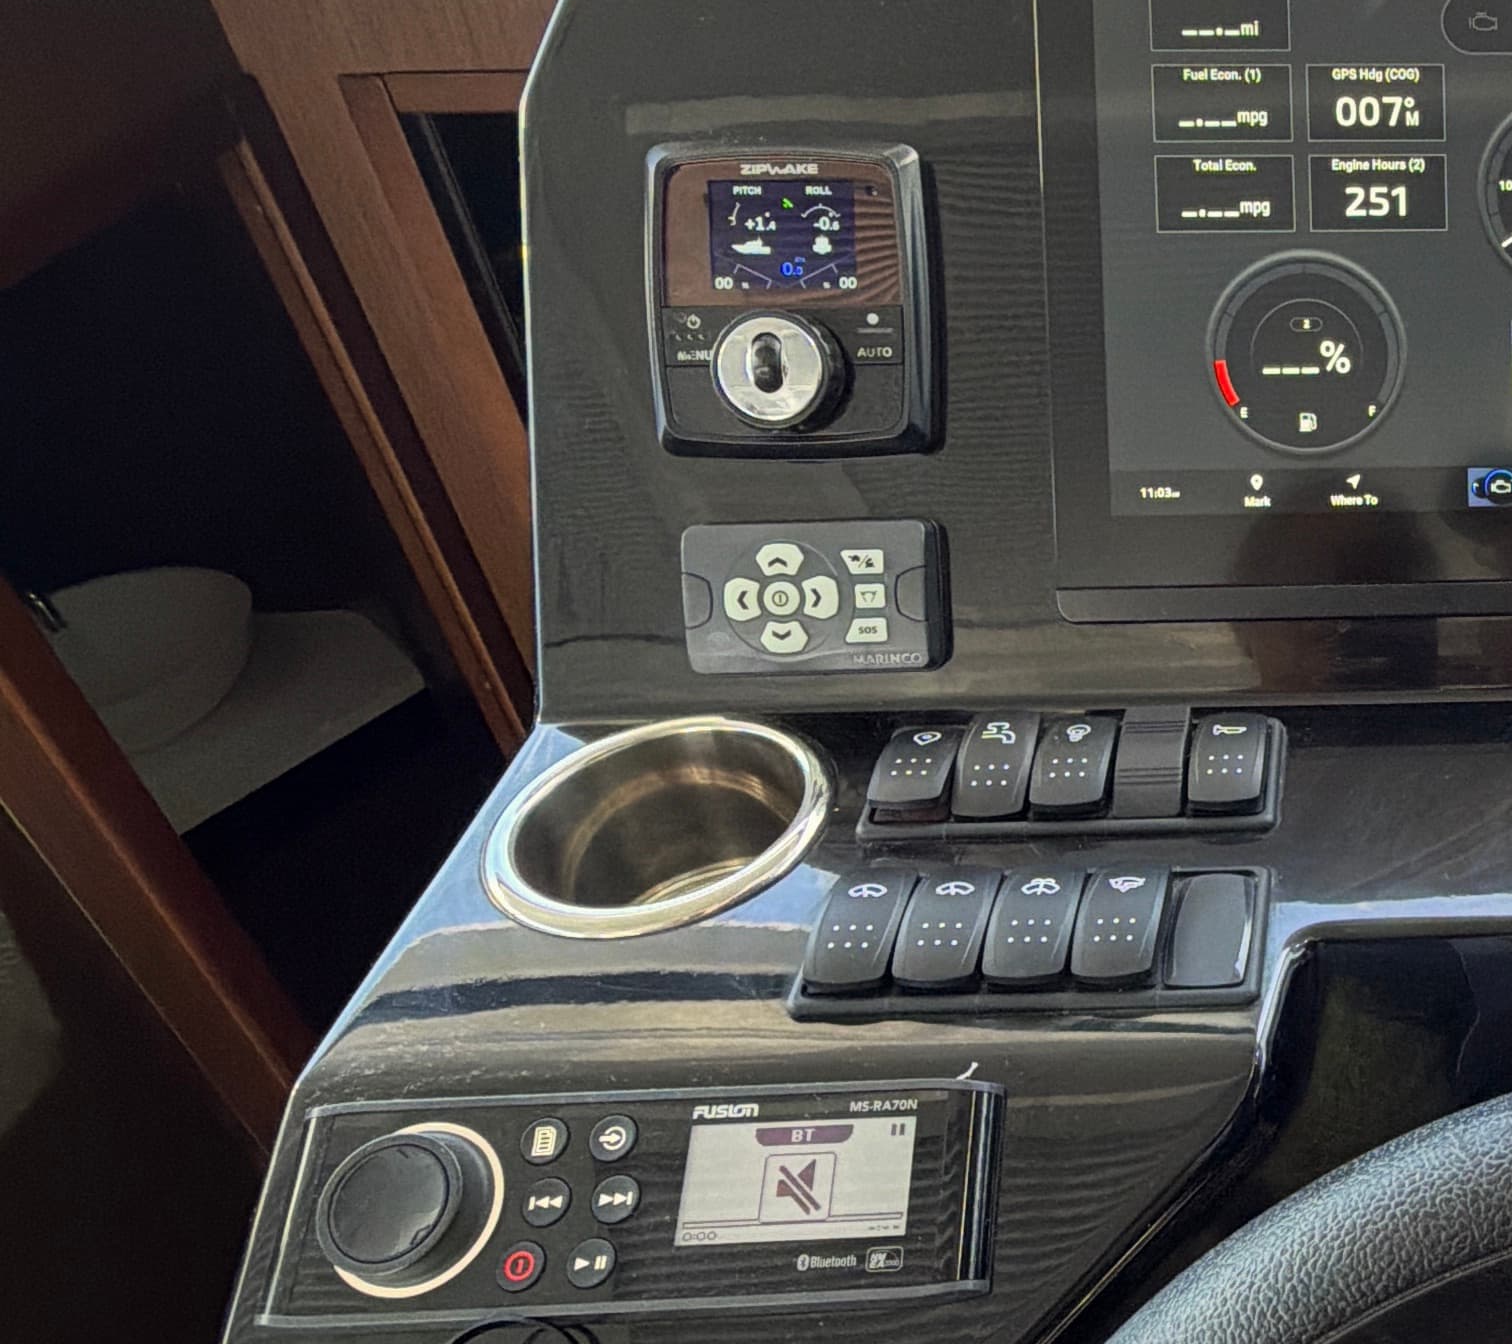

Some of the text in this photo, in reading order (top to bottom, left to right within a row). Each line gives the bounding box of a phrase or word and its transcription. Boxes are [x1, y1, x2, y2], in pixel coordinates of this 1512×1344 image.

[1183, 68, 1262, 83] Fuel Econ. (1)
[1332, 66, 1420, 84] GPS Hdg (COG)
[740, 163, 819, 175] ZIPWAKE
[1193, 158, 1256, 172] Total Econ.
[1332, 157, 1425, 173] Engine Hours (2)
[732, 185, 762, 196] PITCH
[805, 185, 833, 196] ROLL
[1344, 185, 1408, 217] 251
[714, 276, 734, 290] 00
[839, 276, 858, 290] 00
[857, 346, 893, 358] AUTO
[1240, 407, 1248, 419] E
[1368, 405, 1376, 417] F
[1244, 496, 1272, 507] Mark
[1330, 494, 1379, 507] Where To
[858, 626, 878, 635] SOS
[692, 1102, 760, 1121] FUSION
[849, 1098, 918, 1114] MS-RA70N
[791, 1128, 815, 1143] BT
[809, 1254, 857, 1269] Bluetooth
